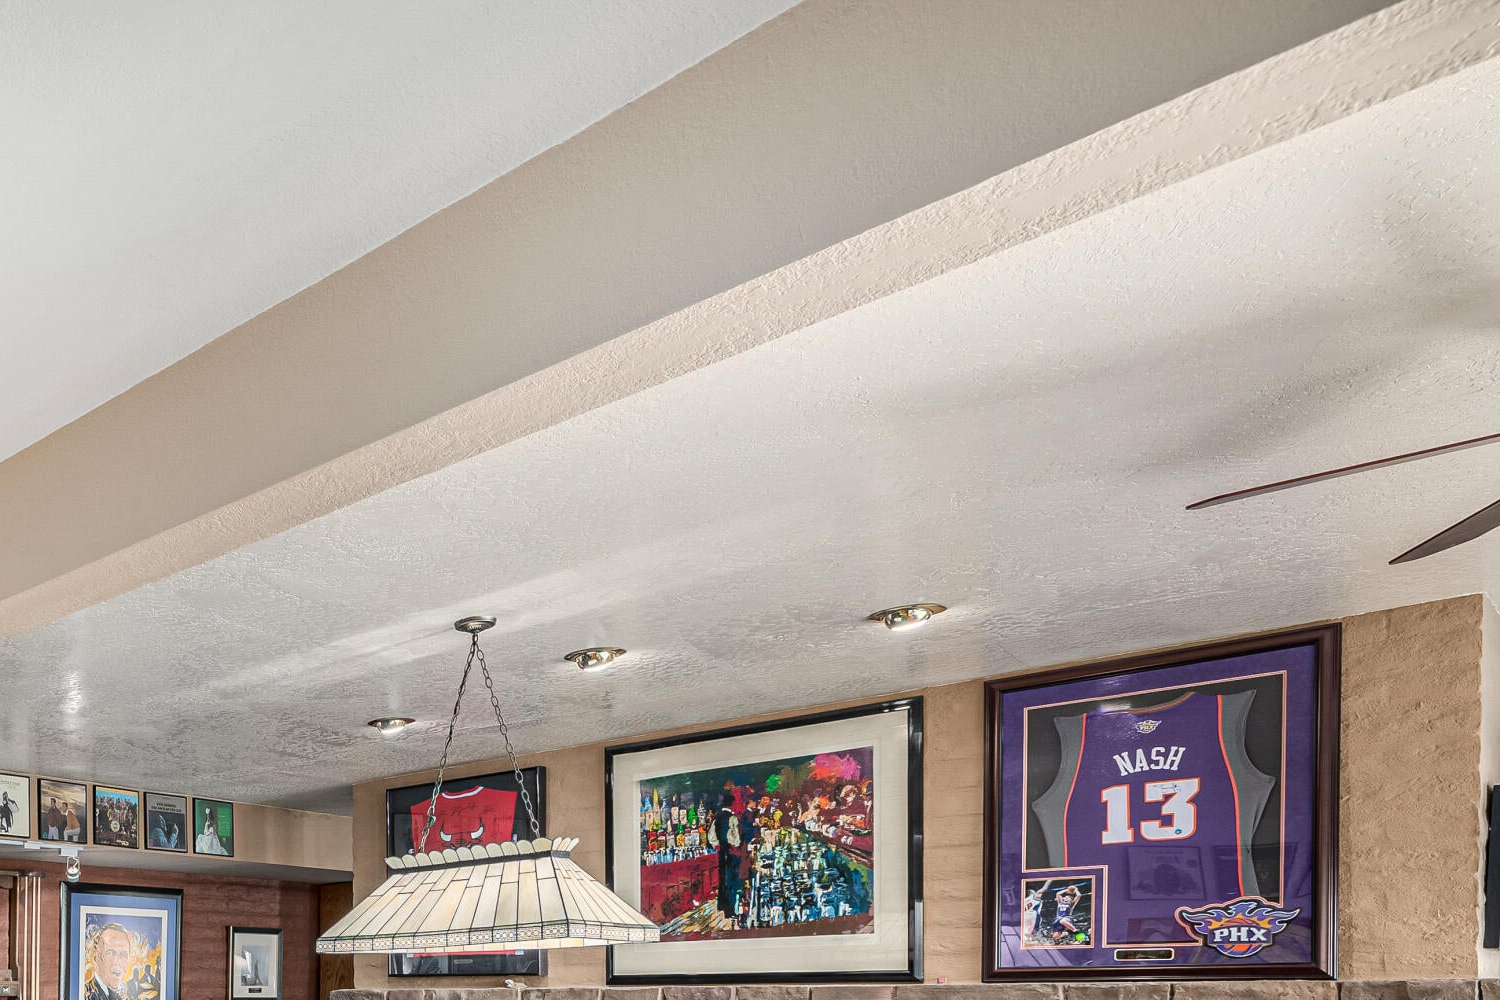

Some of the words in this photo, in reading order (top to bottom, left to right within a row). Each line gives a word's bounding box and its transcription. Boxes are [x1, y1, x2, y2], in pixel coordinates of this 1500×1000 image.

[1113, 746, 1186, 776] NASH
[1101, 777, 1201, 845] 13
[1213, 926, 1268, 943] PHX
